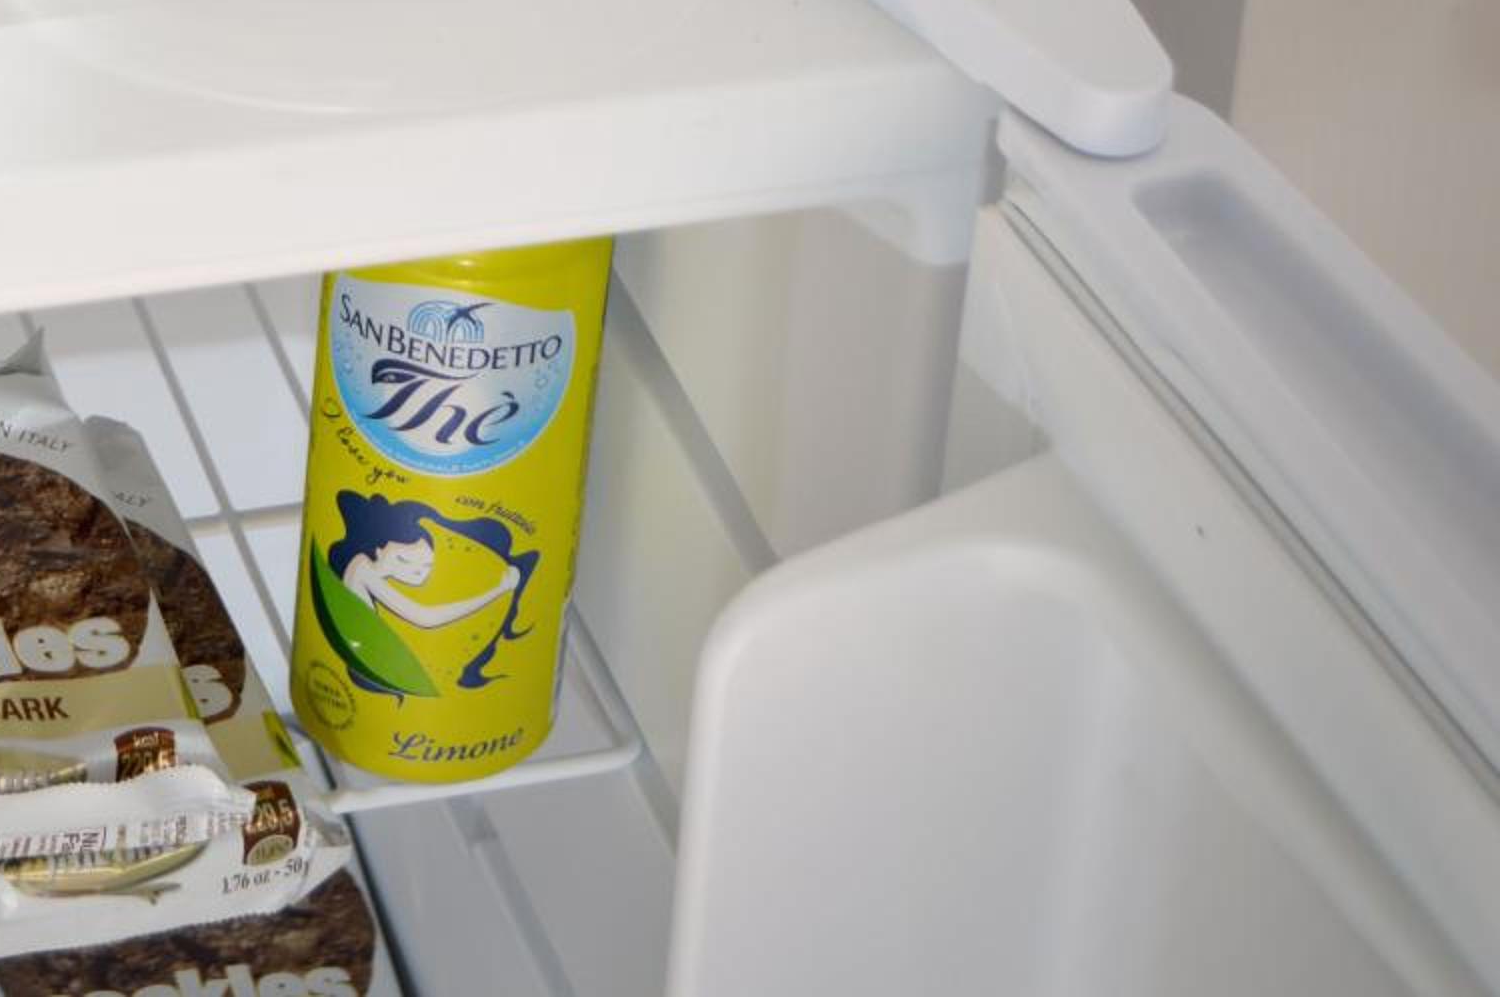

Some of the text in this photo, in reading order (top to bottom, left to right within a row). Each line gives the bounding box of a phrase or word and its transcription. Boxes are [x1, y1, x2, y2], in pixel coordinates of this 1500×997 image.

[363, 358, 520, 445] Thè
[17, 428, 73, 455] ITALY
[388, 727, 524, 762] Limone
